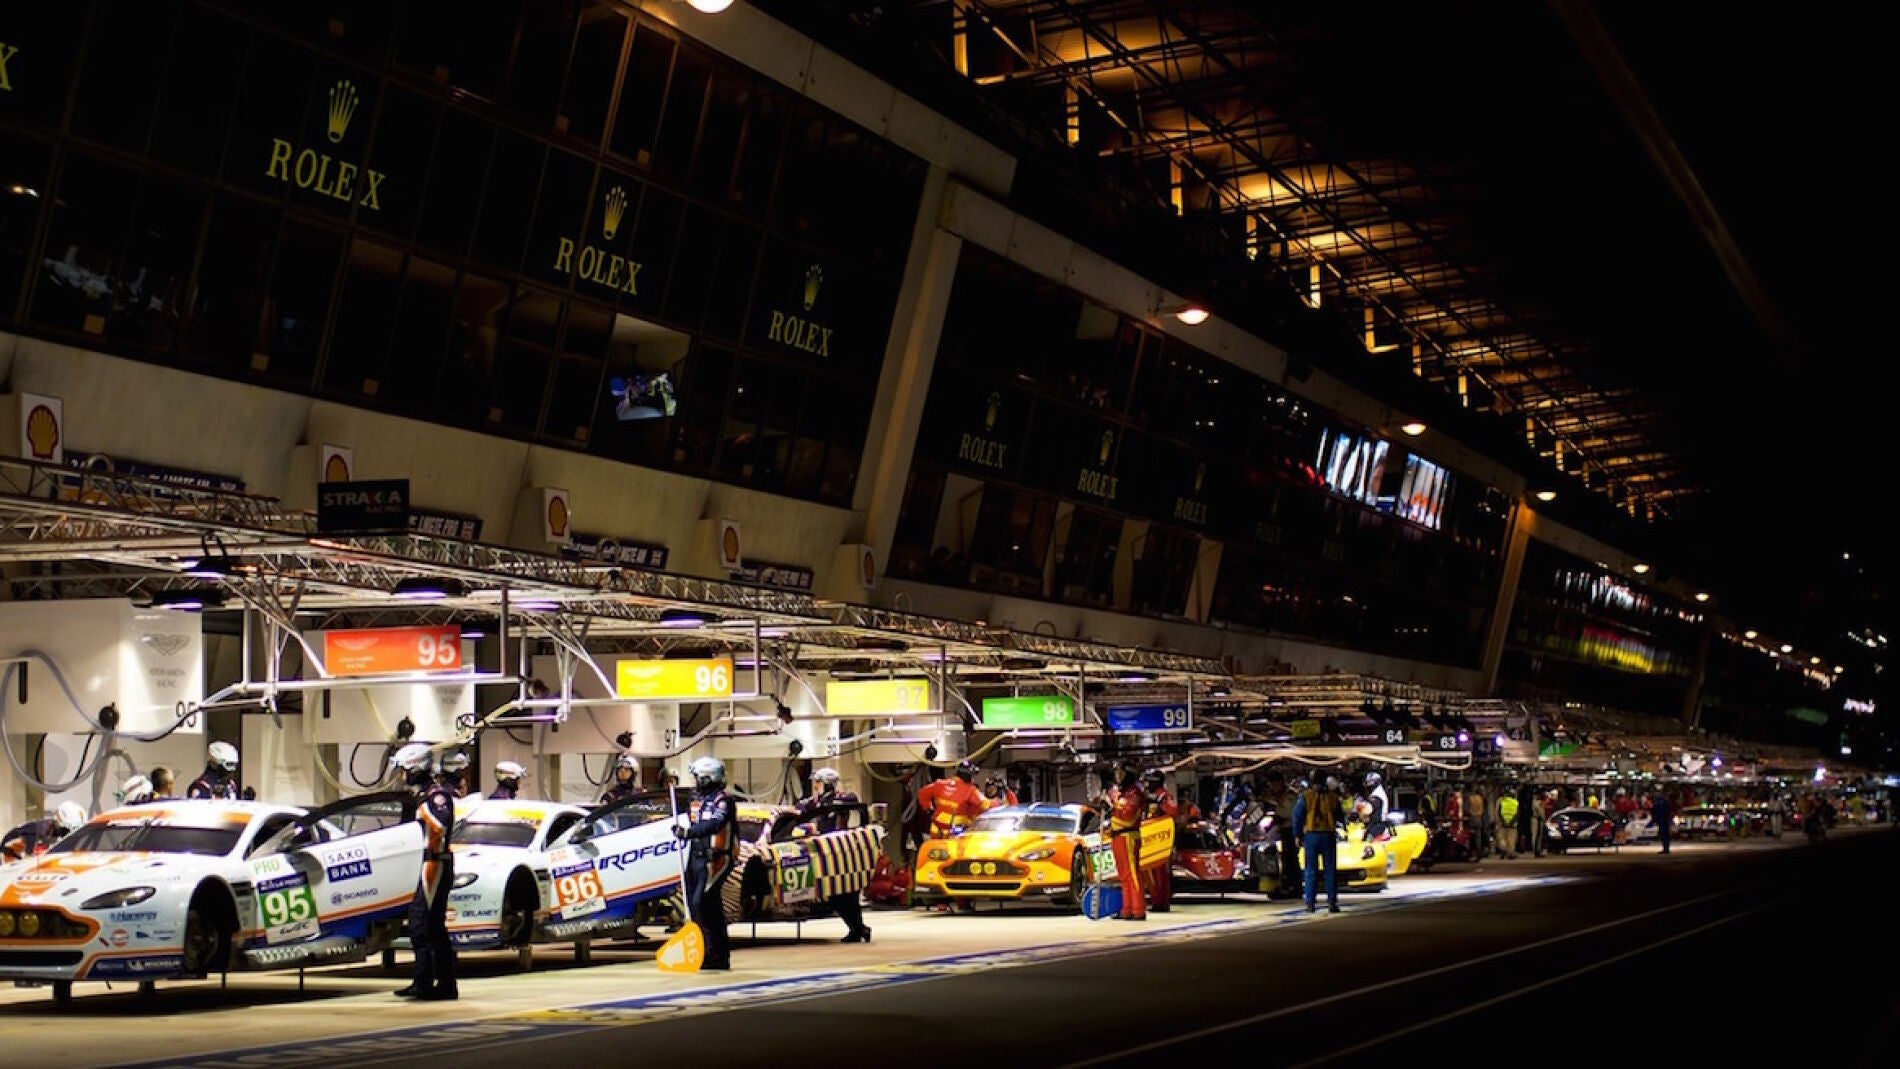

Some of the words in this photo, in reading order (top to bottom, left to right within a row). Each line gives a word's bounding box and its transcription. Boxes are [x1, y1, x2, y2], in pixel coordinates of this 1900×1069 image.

[265, 138, 386, 211] ROLEX
[553, 236, 643, 296] ROLEX
[767, 309, 834, 359] ROLEX
[958, 431, 1008, 471] ROLEX
[1076, 466, 1120, 500] ROLEX
[418, 634, 456, 666] 95
[695, 665, 728, 693] 96
[895, 686, 924, 709] 97
[1042, 701, 1069, 721] 98
[1163, 708, 1187, 727] 99
[664, 728, 677, 750] 97
[1386, 729, 1404, 744] 64
[1440, 735, 1457, 749] 63
[253, 858, 280, 875] PRO
[328, 849, 364, 863] SAXO
[331, 861, 369, 878] BANK
[784, 866, 808, 891] 97
[559, 872, 599, 904] 96
[264, 888, 311, 926] 95
